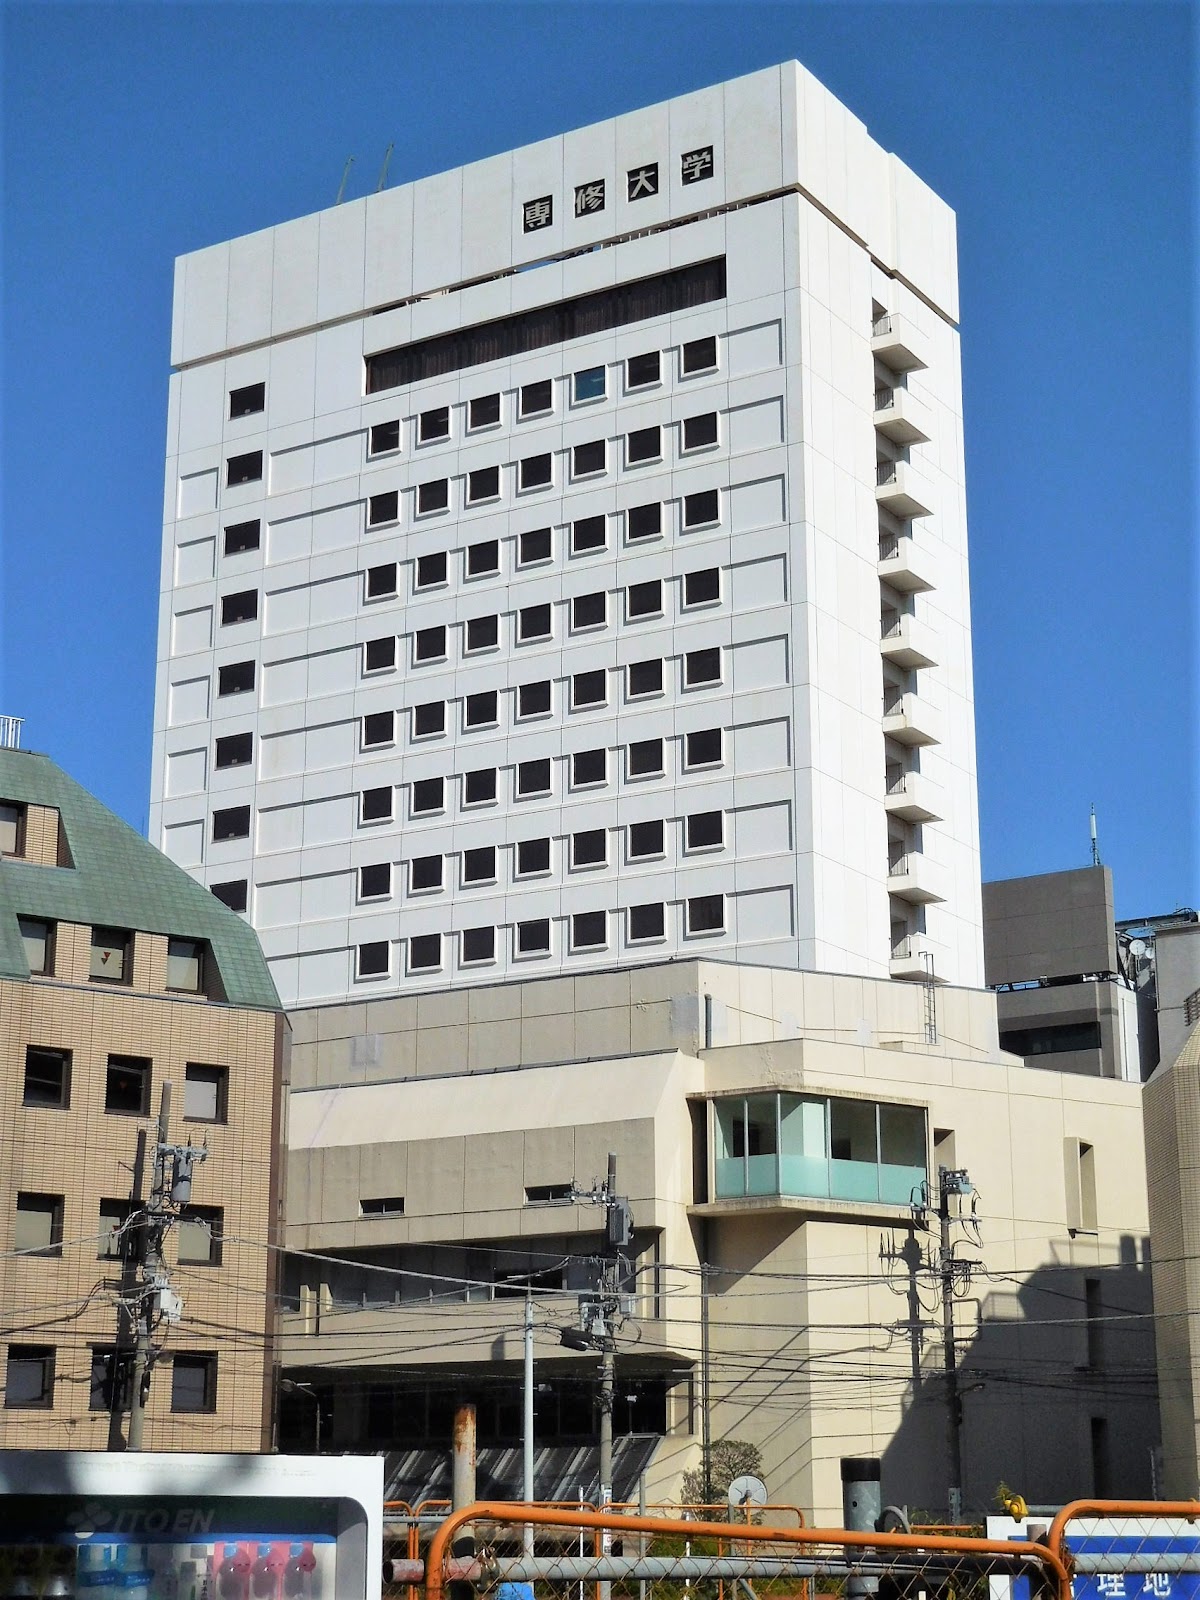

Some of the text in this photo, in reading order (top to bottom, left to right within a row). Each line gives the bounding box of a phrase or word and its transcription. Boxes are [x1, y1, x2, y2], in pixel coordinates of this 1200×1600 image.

[525, 151, 712, 228] 専修大学
[113, 1508, 215, 1533] ITO EN
[1069, 1573, 1171, 1598] 理地
